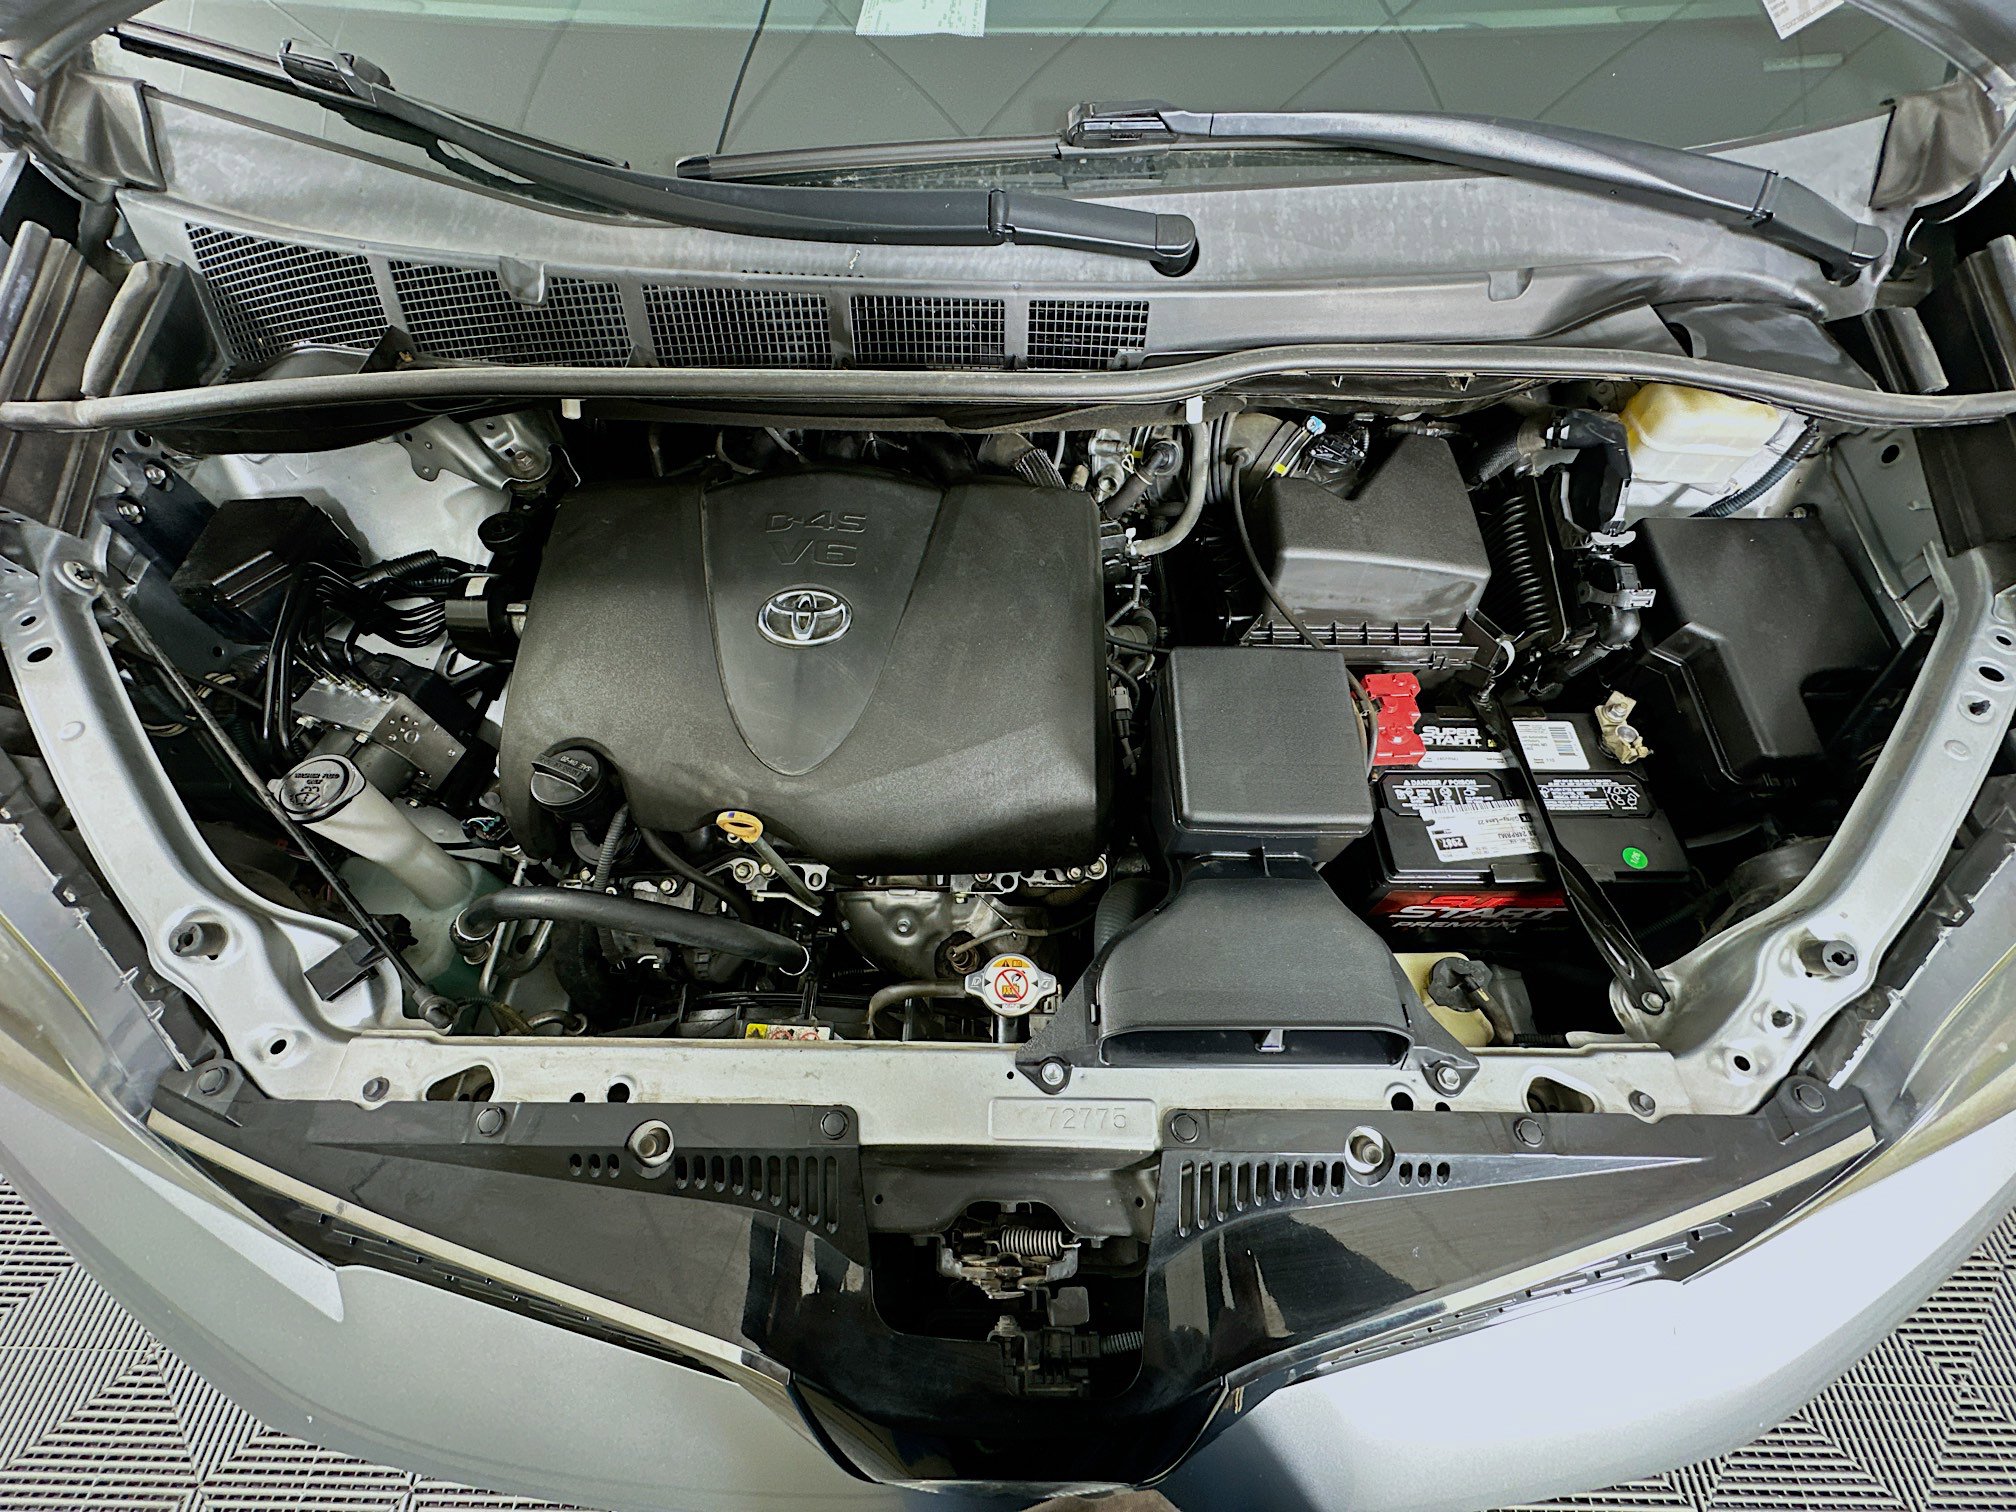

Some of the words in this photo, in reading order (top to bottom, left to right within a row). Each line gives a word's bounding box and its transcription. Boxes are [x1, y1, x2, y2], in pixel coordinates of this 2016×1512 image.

[768, 540, 857, 566] V6
[1422, 726, 1479, 737] SUPER
[1420, 735, 1481, 747] START
[1389, 906, 1568, 919] START
[1046, 1107, 1127, 1129] 72775
